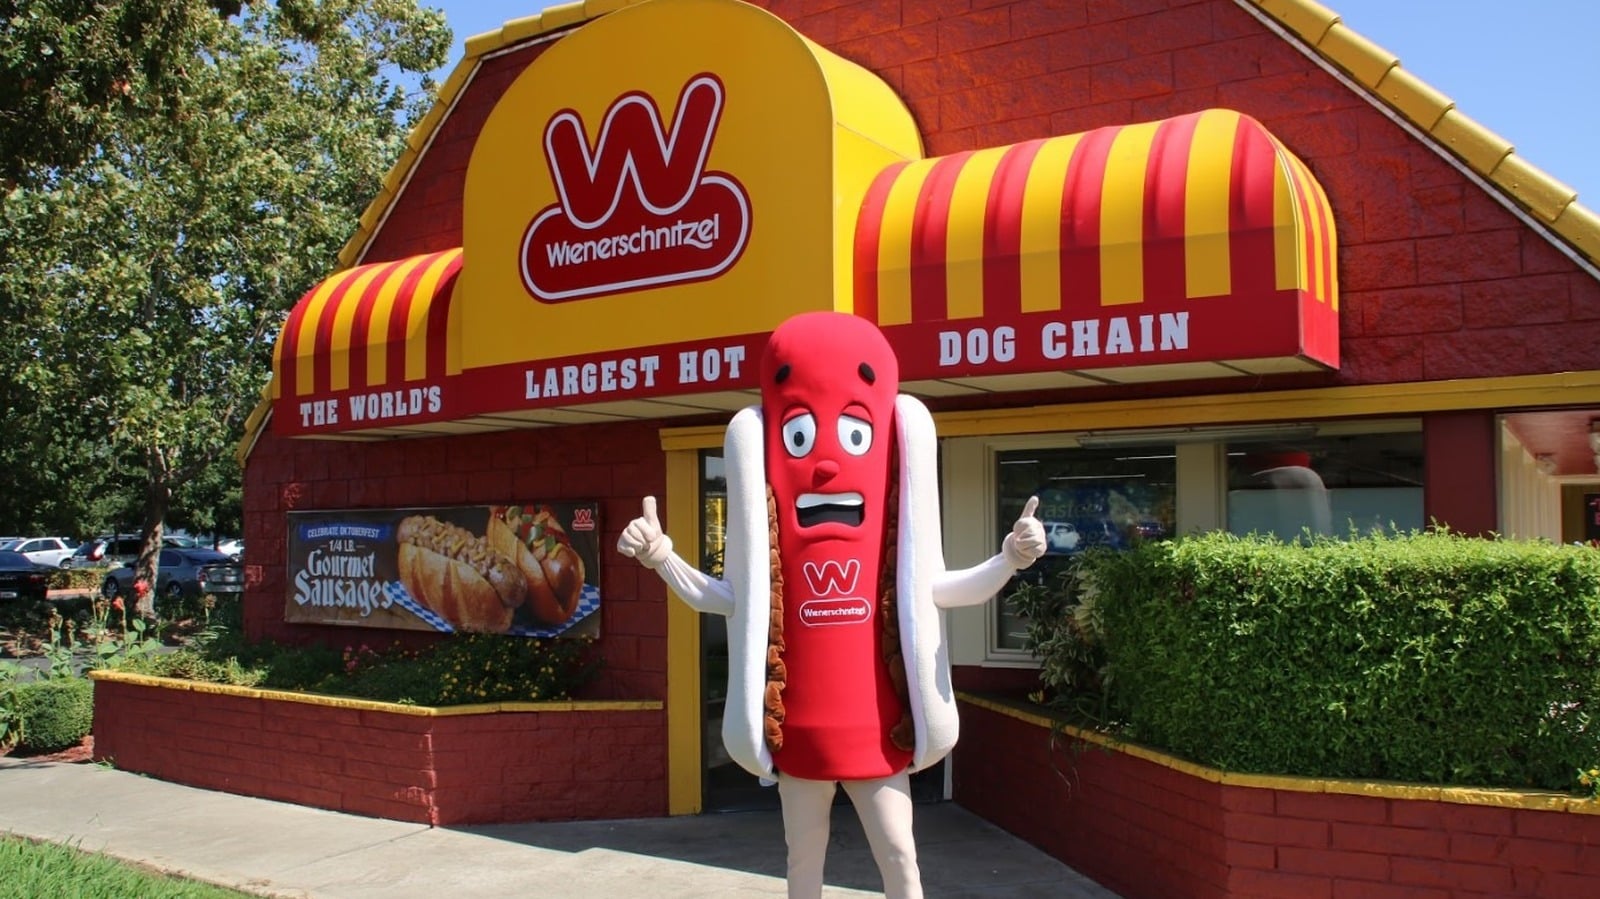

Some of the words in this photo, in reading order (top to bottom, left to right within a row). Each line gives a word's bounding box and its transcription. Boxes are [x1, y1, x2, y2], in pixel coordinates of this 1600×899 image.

[545, 76, 723, 231] W
[545, 213, 720, 269] Wienerschnitzel
[299, 399, 338, 428] THE
[349, 386, 442, 422] WORLD'S
[525, 355, 660, 400] LARGEST
[678, 345, 746, 385] HOT
[939, 326, 1016, 367] DOG
[1041, 311, 1190, 360] CHAIN
[307, 525, 339, 539] CELEBRATE
[339, 525, 380, 539] OKTOBERFEST
[329, 539, 342, 552] 1/4
[308, 549, 376, 578] Gourmet
[803, 558, 861, 597] W
[294, 569, 393, 617] Sausages
[803, 606, 867, 618] Wienerschnitzel
